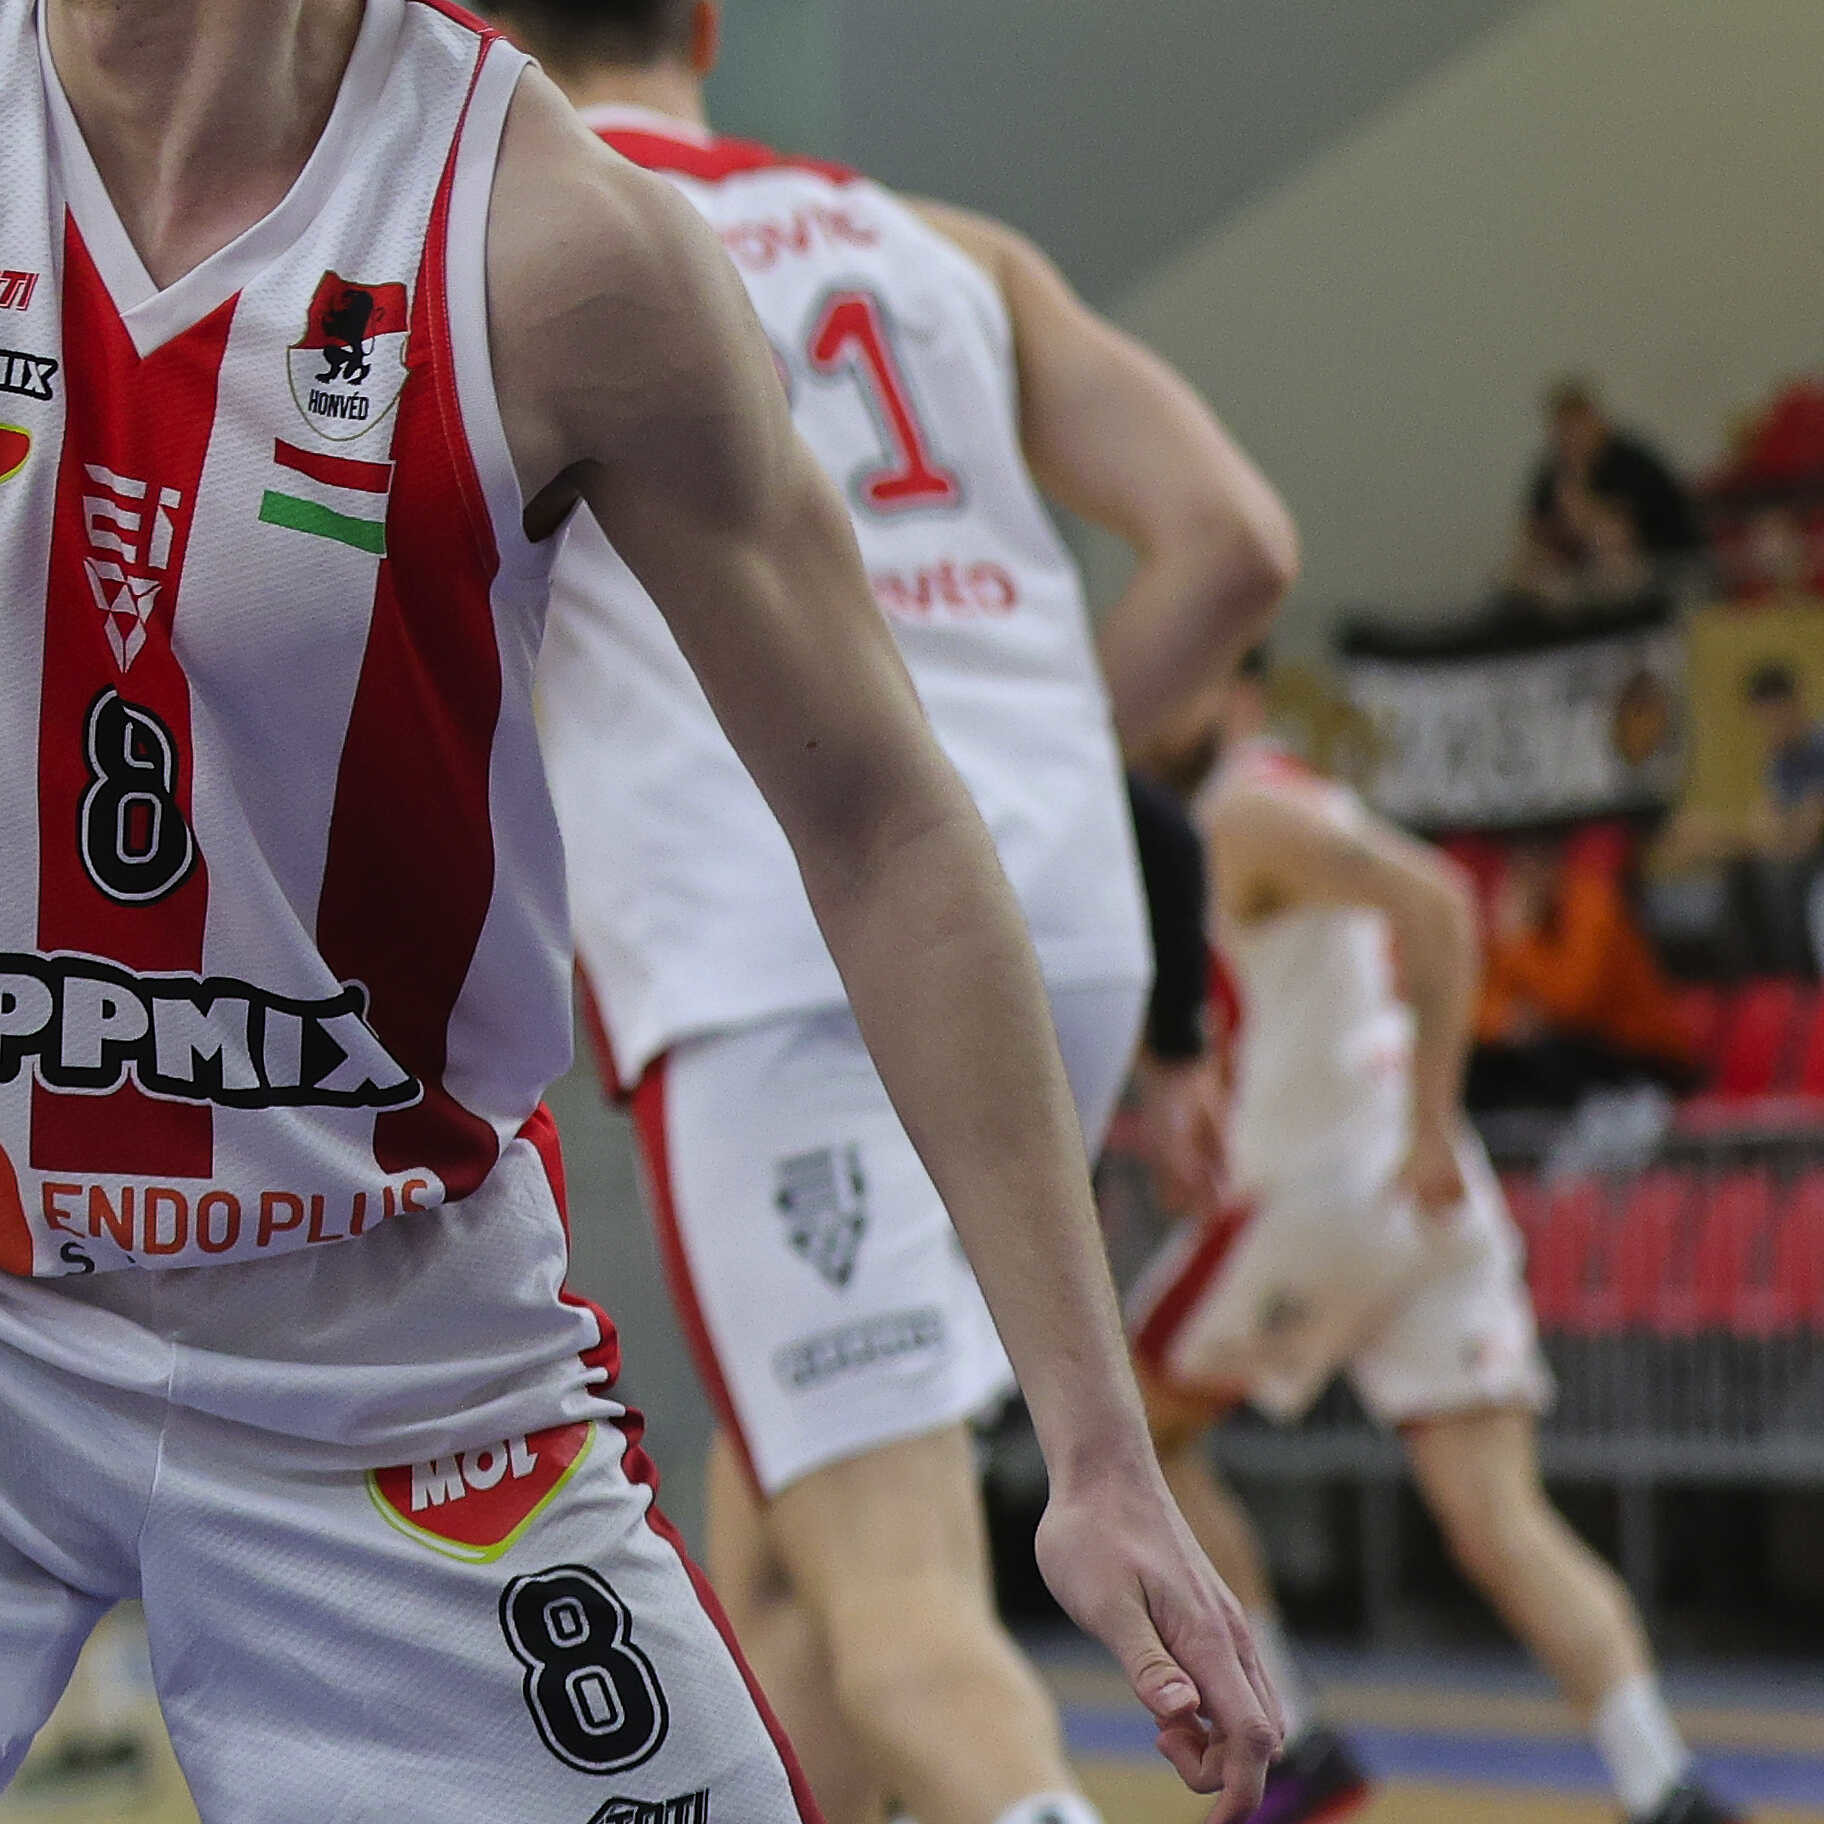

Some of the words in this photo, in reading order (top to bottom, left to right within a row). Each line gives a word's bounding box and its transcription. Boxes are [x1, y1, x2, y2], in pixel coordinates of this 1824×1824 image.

[308, 389, 370, 421] HONVÉD
[76, 682, 199, 908] 8
[42, 1181, 241, 1255] ENDO
[410, 1433, 540, 1513] MOL
[499, 1564, 670, 1776] 8
